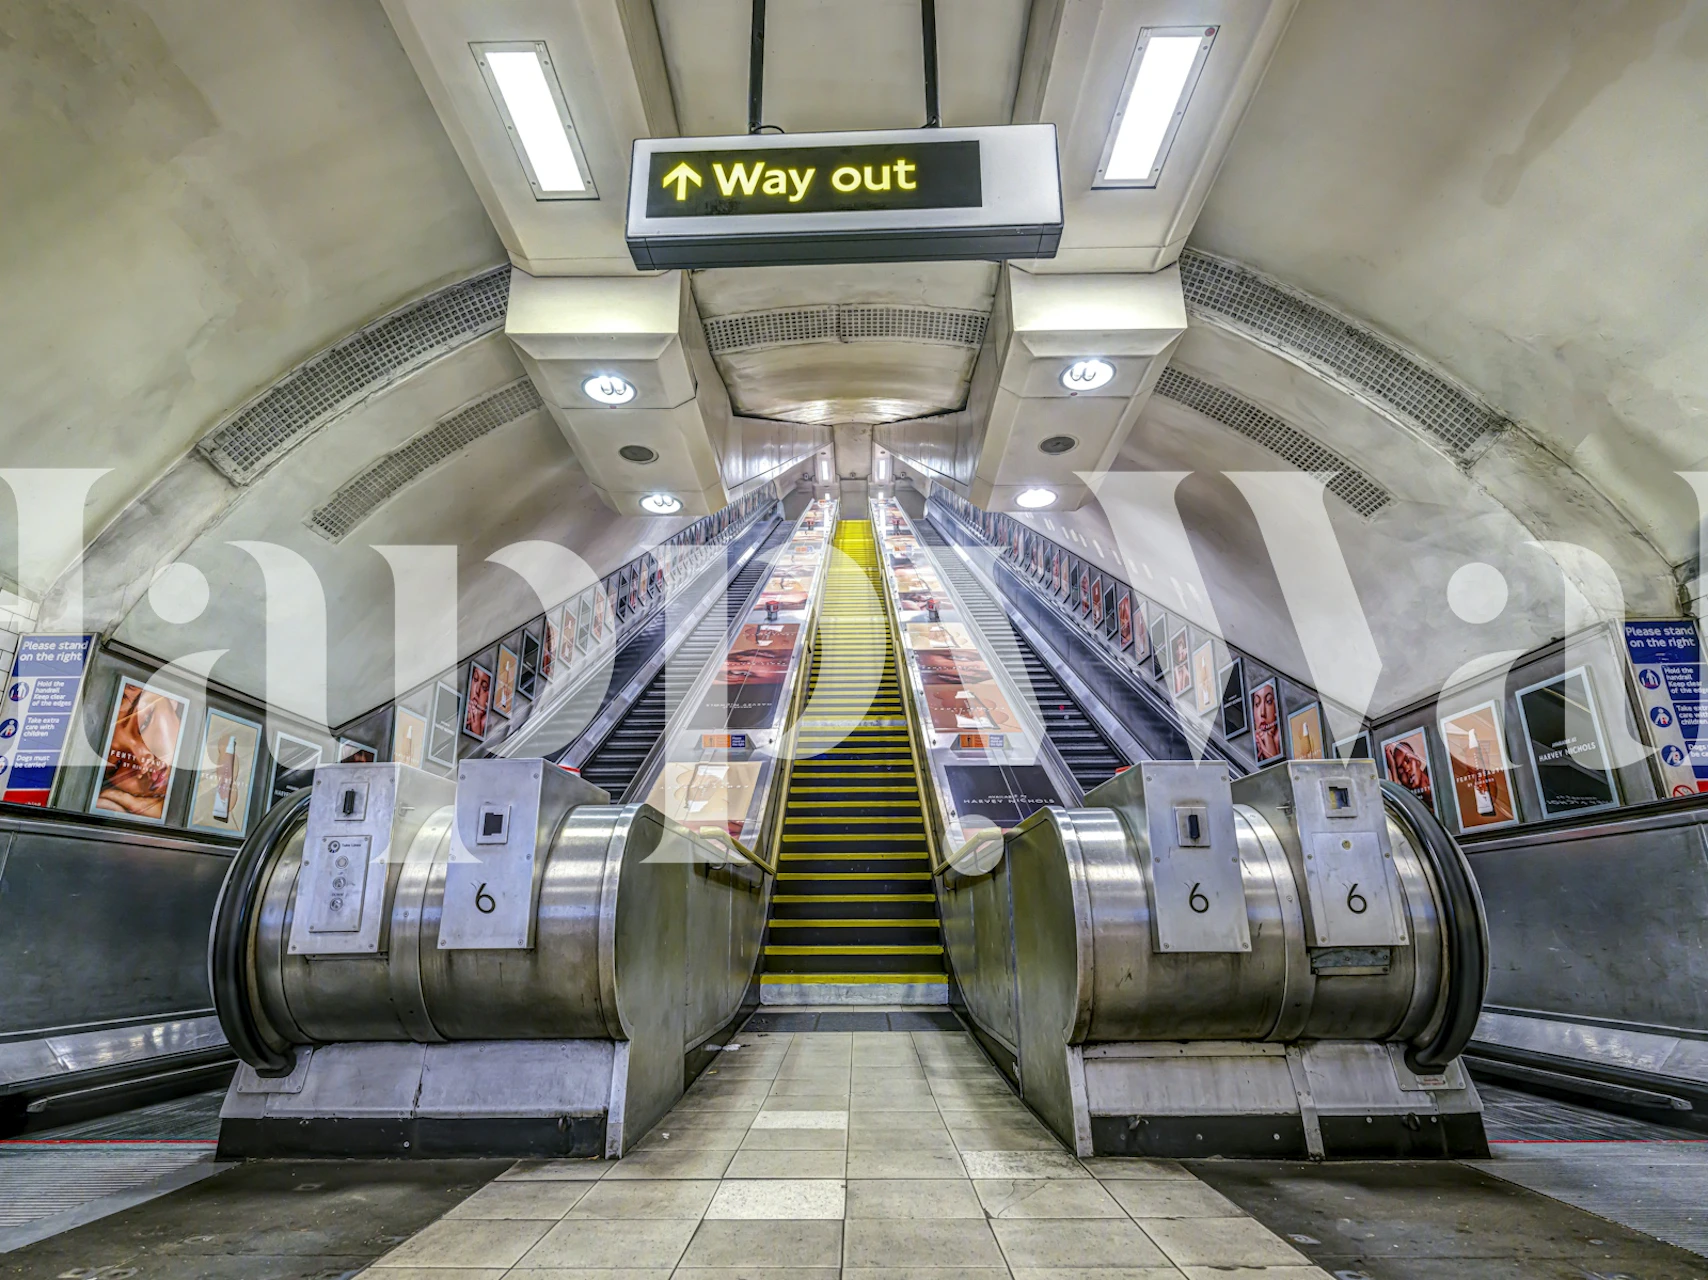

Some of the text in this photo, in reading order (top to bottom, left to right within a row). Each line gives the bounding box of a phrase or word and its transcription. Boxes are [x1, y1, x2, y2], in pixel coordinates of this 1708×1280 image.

[712, 158, 917, 203] Way out
[1625, 625, 1695, 638] Please stand
[22, 639, 88, 650] Please stand
[1629, 636, 1696, 649] on the right
[19, 651, 83, 663] on the right
[1664, 666, 1694, 674] Hold the
[1668, 680, 1686, 688] Keep
[1693, 687, 1708, 695] edge
[53, 700, 72, 708] edges
[1676, 704, 1708, 712] Take extr
[110, 750, 136, 761] FENTY
[1538, 742, 1596, 762] HARVEY NICHOLS
[16, 754, 33, 762] Dogs
[1456, 774, 1474, 783] FENTY
[474, 882, 496, 914] 6
[1188, 882, 1210, 914] 6
[1346, 882, 1368, 914] 6
